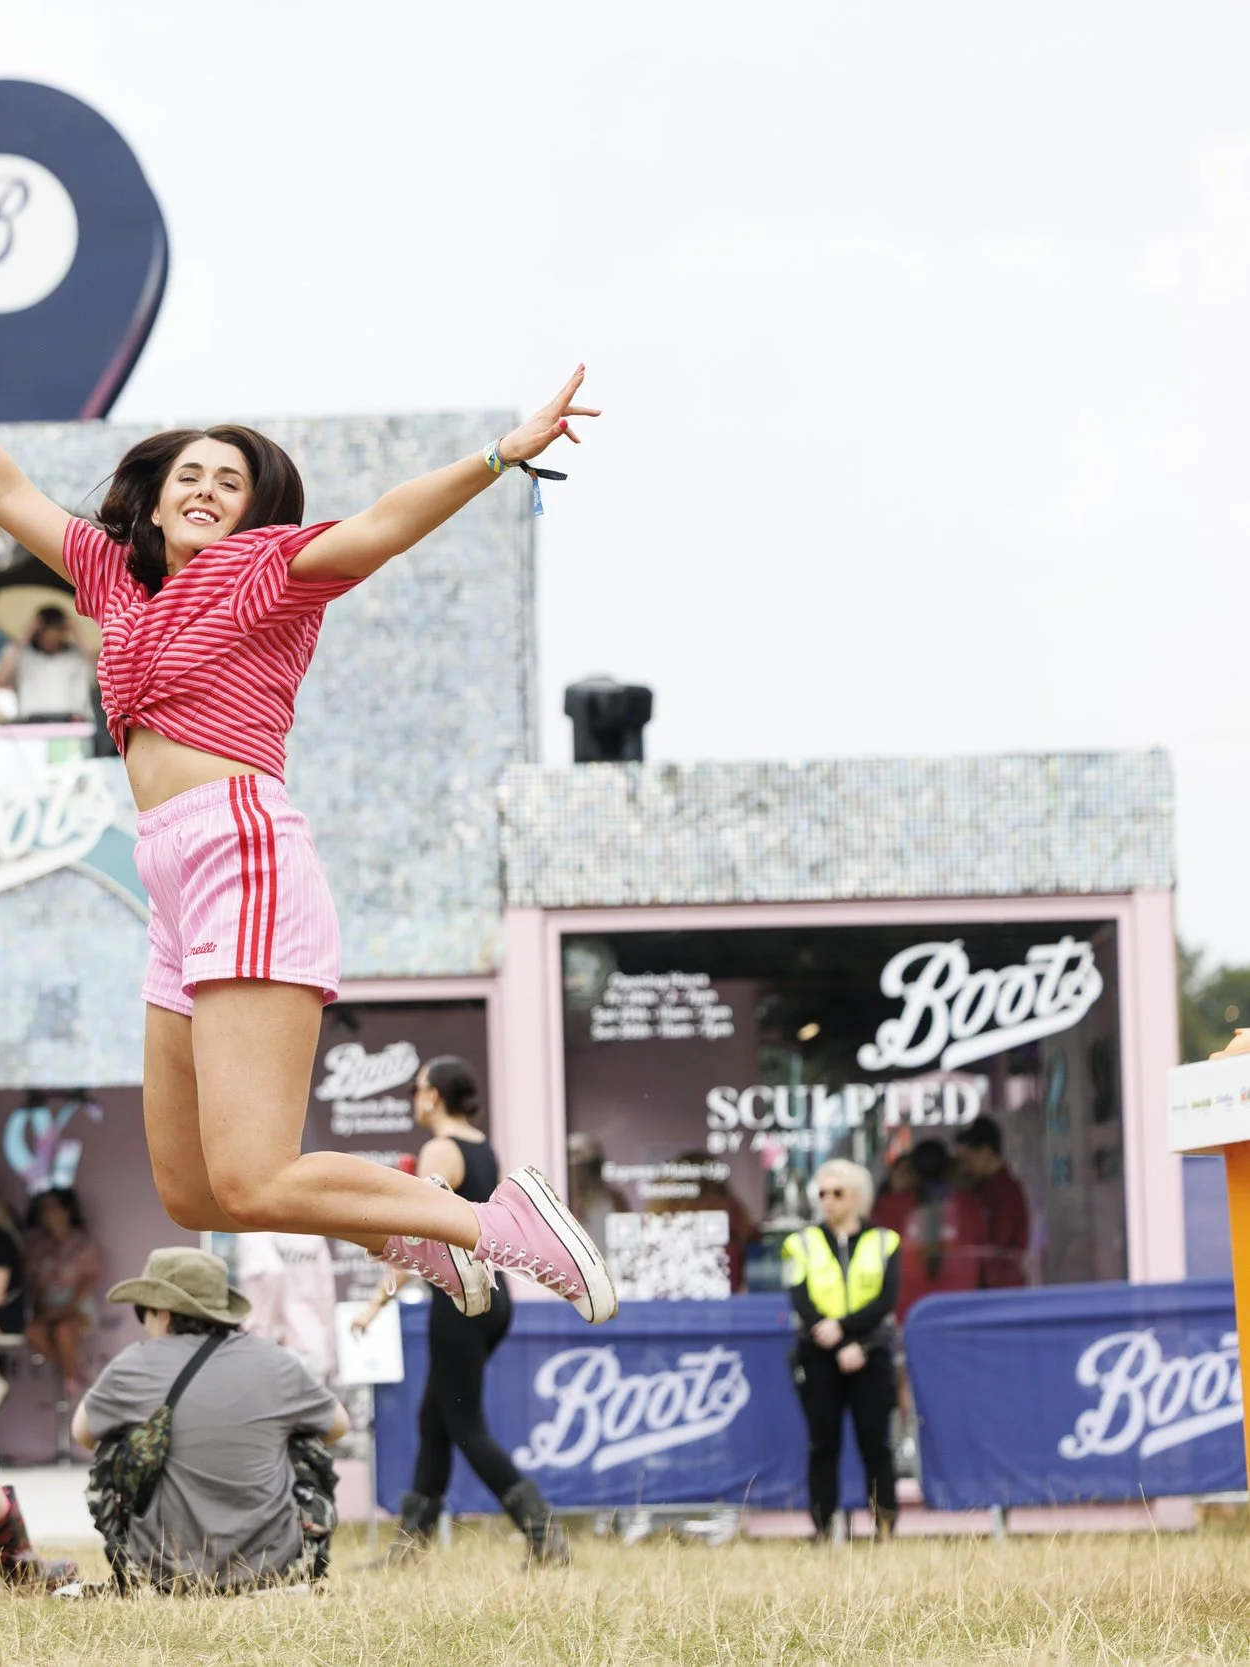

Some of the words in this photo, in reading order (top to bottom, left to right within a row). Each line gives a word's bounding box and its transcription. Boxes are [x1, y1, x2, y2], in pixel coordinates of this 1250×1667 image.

[857, 935, 1104, 1071] Boots
[706, 1082, 982, 1129] SCULPTED
[513, 1344, 751, 1474] Boots
[1057, 1327, 1244, 1460] Boo
